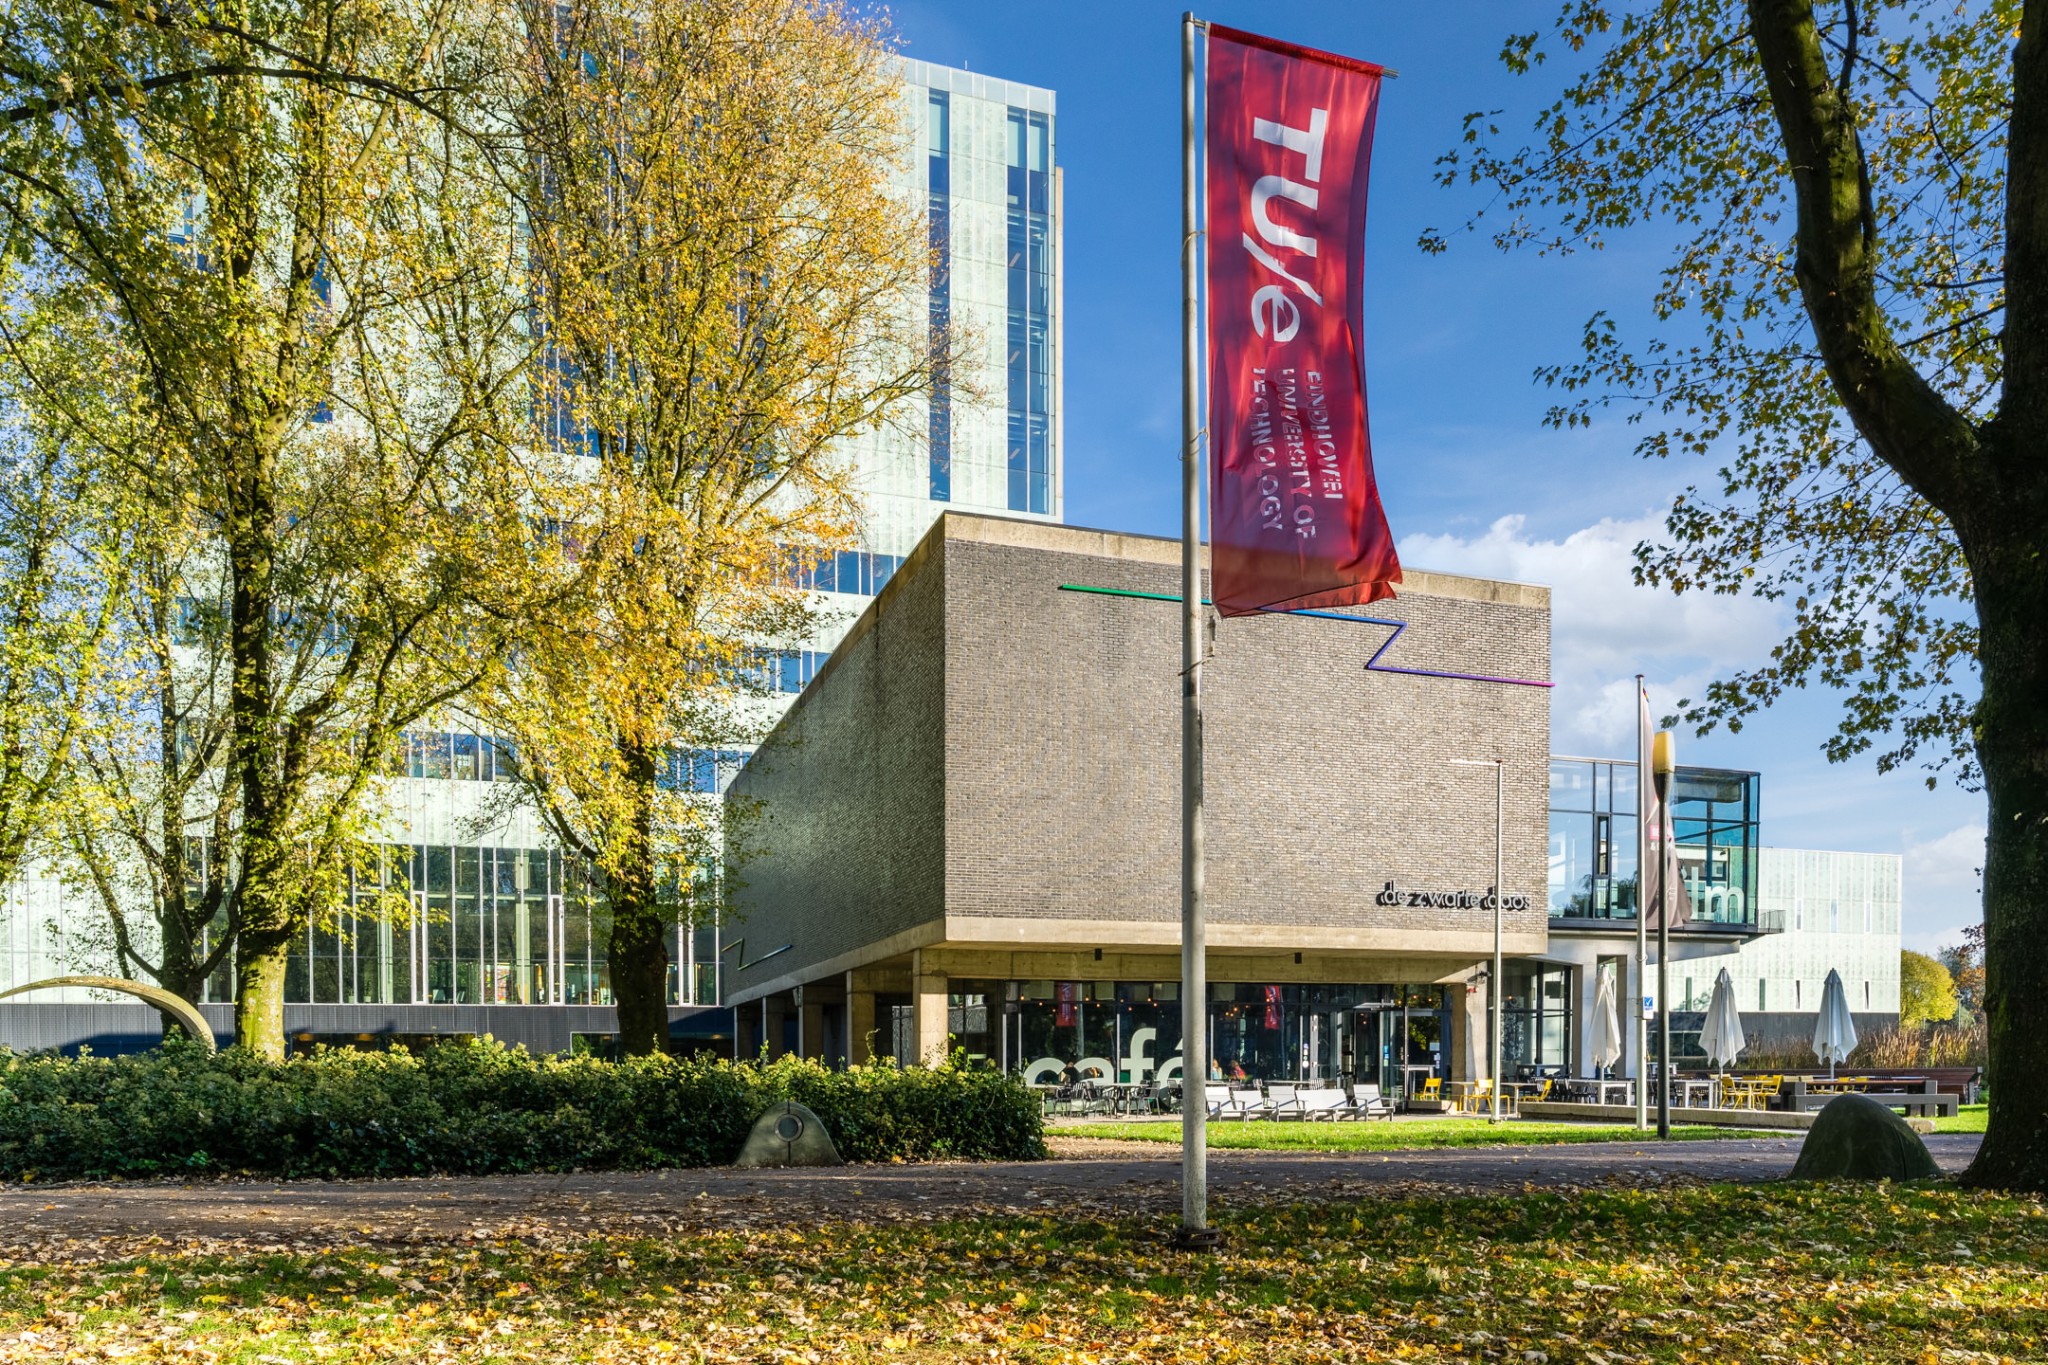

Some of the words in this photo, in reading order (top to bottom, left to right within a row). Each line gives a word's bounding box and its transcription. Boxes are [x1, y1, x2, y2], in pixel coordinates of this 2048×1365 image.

[1242, 107, 1328, 343] TU/e
[1249, 367, 1283, 530] TECHNOLOGY
[1274, 368, 1313, 498] UNIVERSITY
[1293, 504, 1316, 538] OF
[1376, 880, 1407, 906] de
[1407, 887, 1480, 909] zwarte
